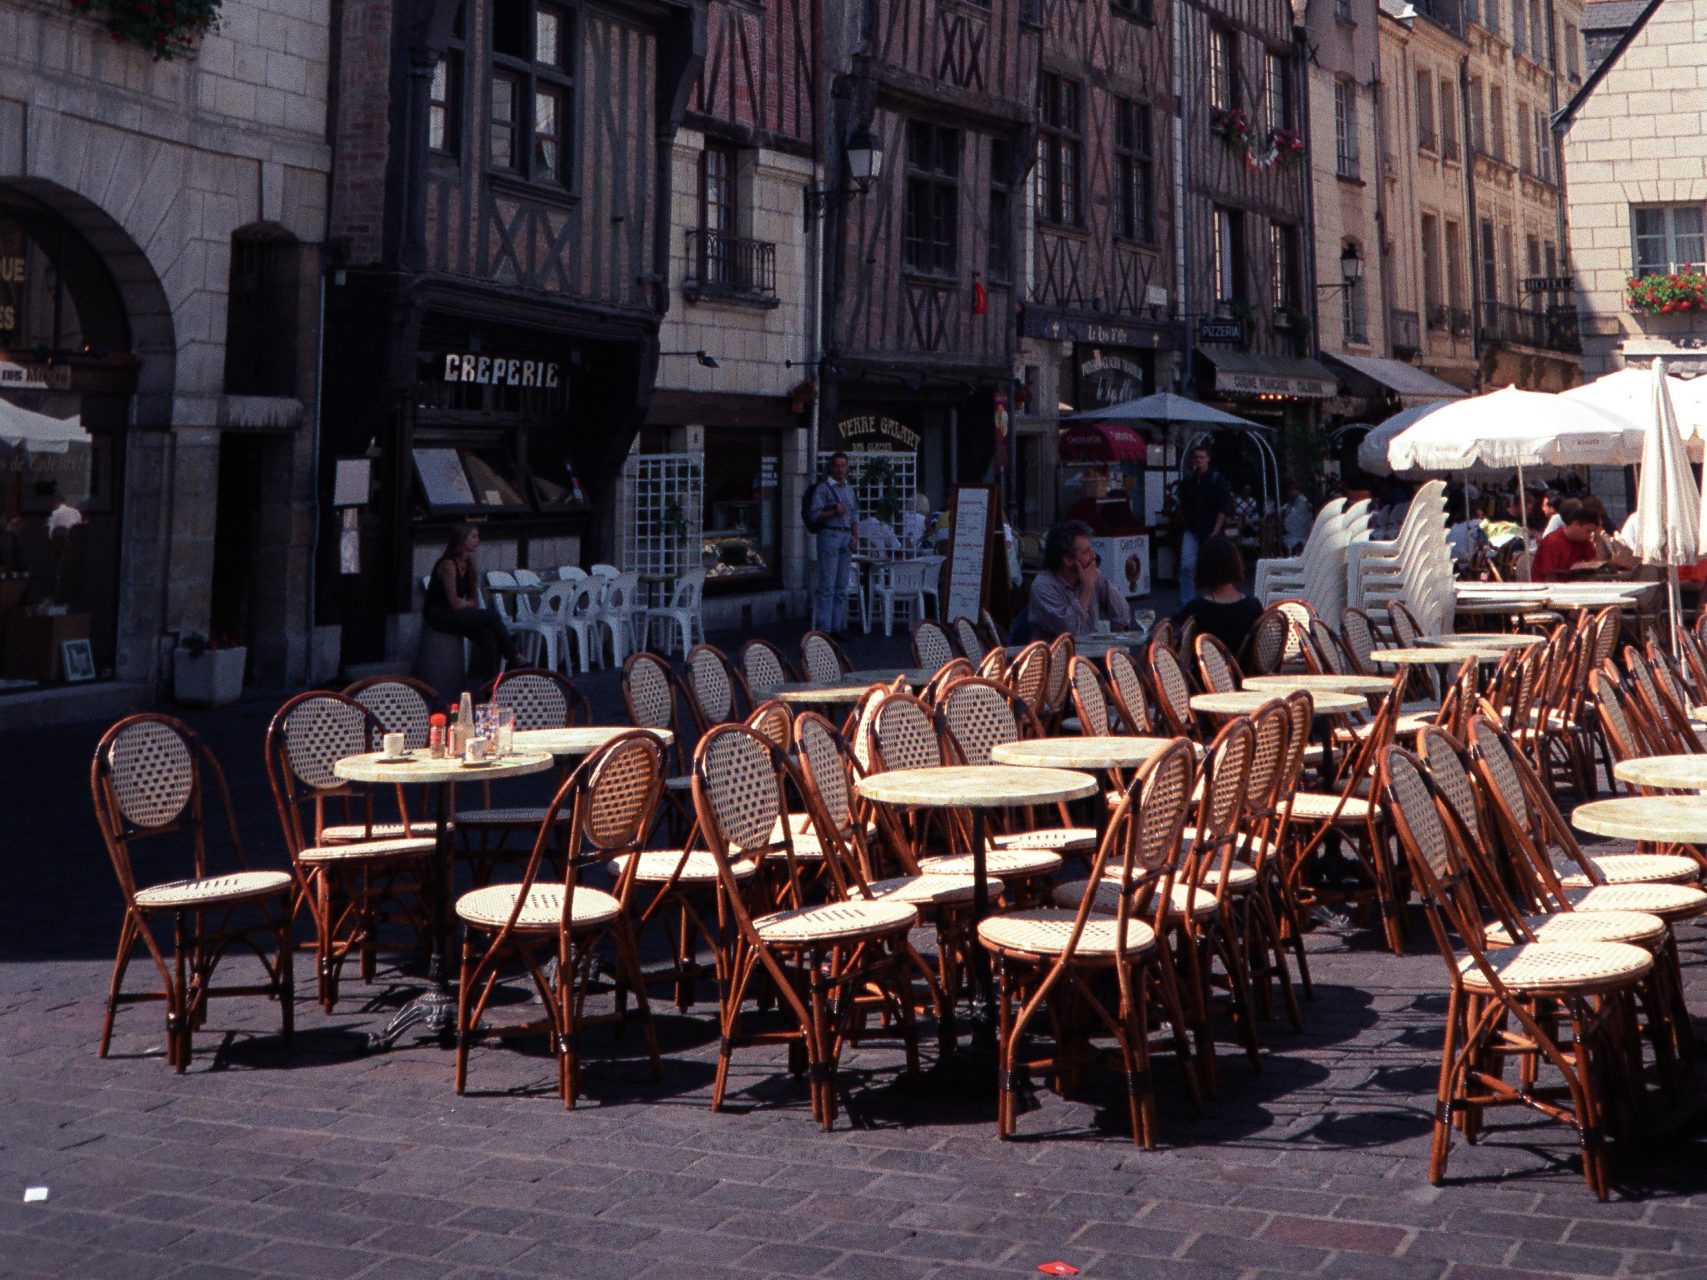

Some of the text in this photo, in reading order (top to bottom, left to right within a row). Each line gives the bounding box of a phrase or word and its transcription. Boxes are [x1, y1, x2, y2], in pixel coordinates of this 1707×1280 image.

[1202, 324, 1241, 338] PIZZERIA
[443, 353, 560, 389] CREPERIE
[838, 416, 922, 451] VERRE GALANT
